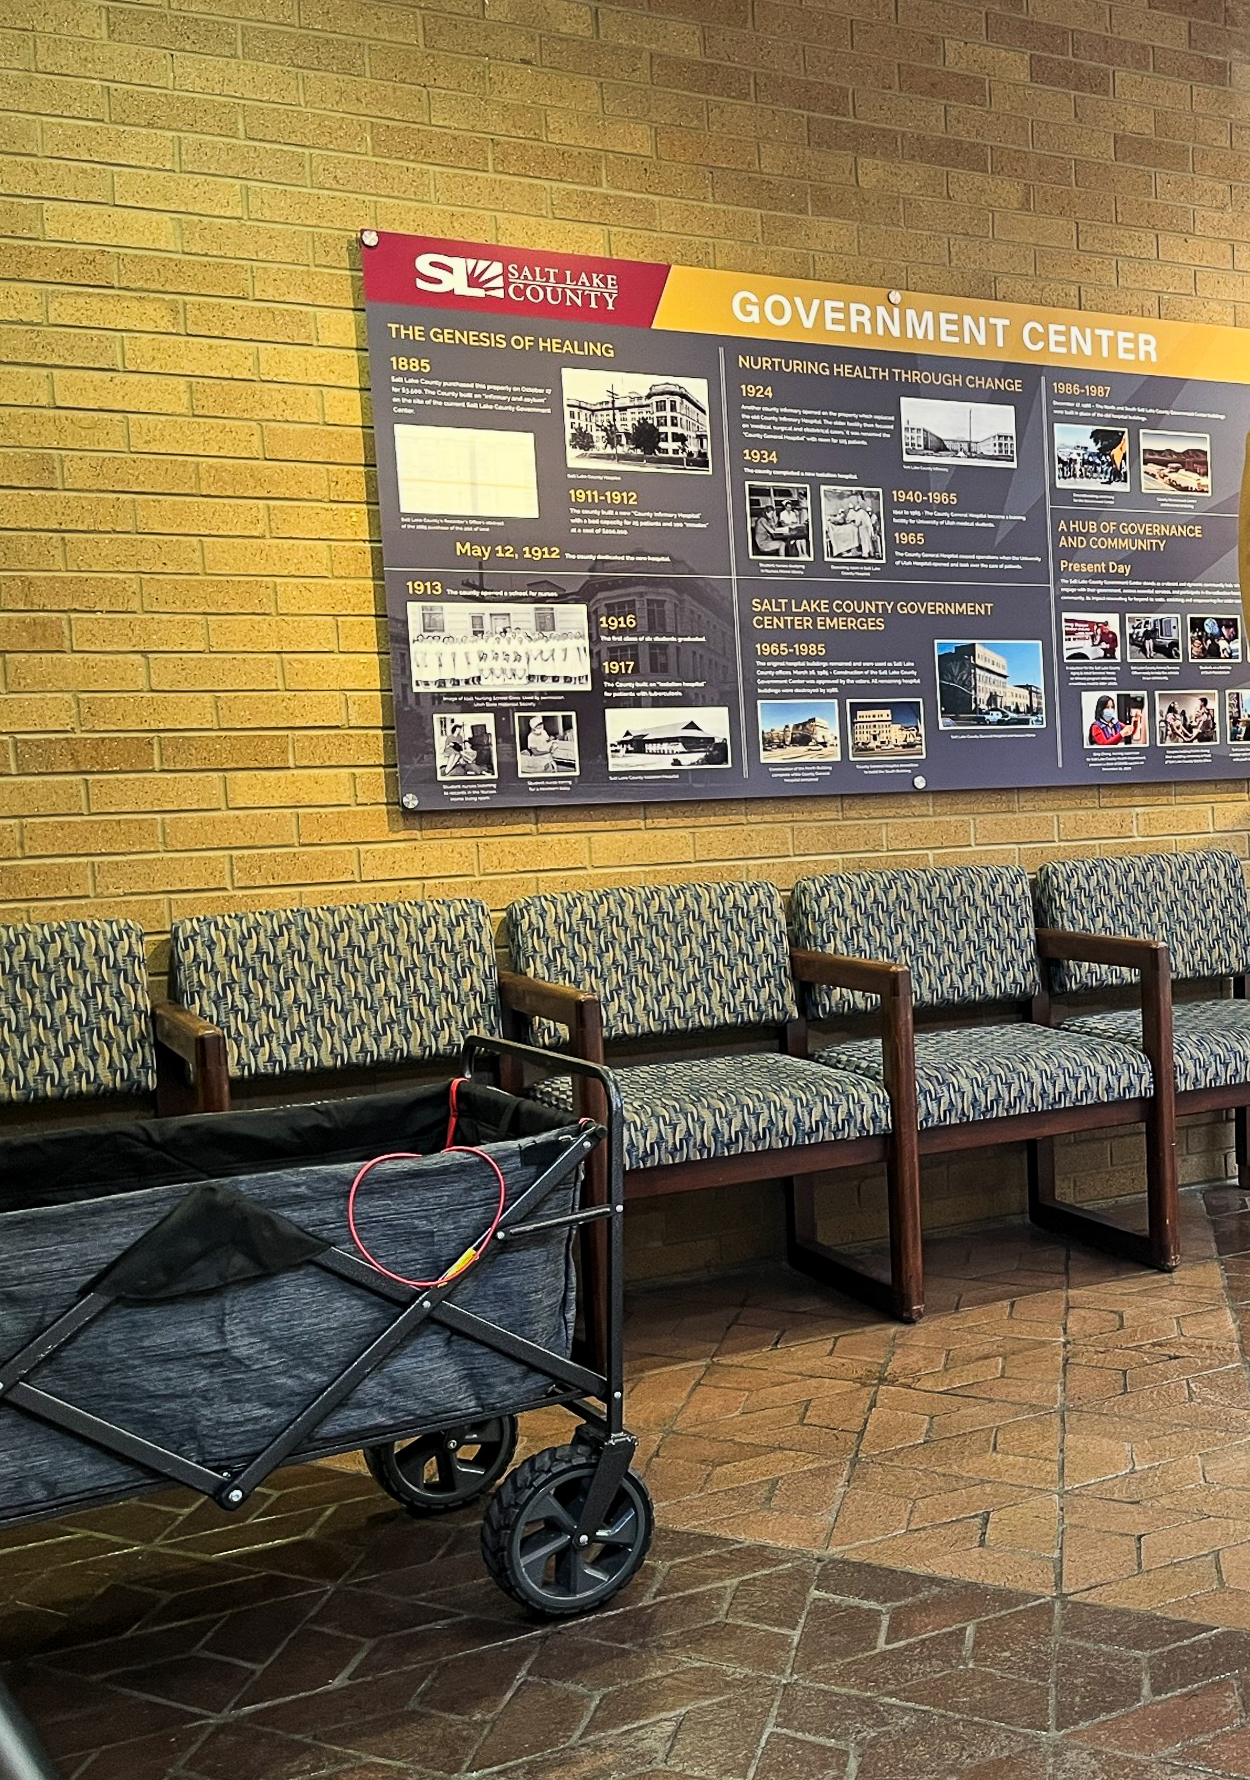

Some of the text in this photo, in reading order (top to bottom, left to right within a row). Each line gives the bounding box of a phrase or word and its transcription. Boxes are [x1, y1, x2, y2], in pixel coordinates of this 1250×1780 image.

[508, 263, 618, 289] SALT LAKE
[508, 282, 618, 310] COUNTY
[732, 290, 1158, 363] GOVERNMENT CENTER
[387, 323, 615, 358] THE GENESIS OF HEALING
[390, 356, 431, 373] 1885
[739, 354, 1023, 392] NURTURING HEALTH THROUGH CHANGE
[420, 378, 443, 386] County
[1053, 381, 1111, 397] 1986-1987
[741, 384, 773, 398] 1924
[743, 449, 778, 463] 1934
[569, 489, 638, 505] 1911-1912
[892, 490, 957, 505] 1940-1965
[1058, 520, 1203, 538] A HUB OF GOVERNANCE
[894, 532, 925, 545] 1965
[1059, 536, 1166, 552] AND COMMUNITY
[456, 541, 561, 561] May 12, 1912
[1060, 560, 1131, 576] Present Day
[406, 580, 442, 595] 1913
[751, 598, 994, 615] SALT LAKE COUNTY GOVERNMENT
[599, 614, 637, 630] 1916
[753, 616, 885, 631] CENTER EMERGES
[755, 643, 826, 656] 1965-1985
[603, 661, 635, 674] 1917
